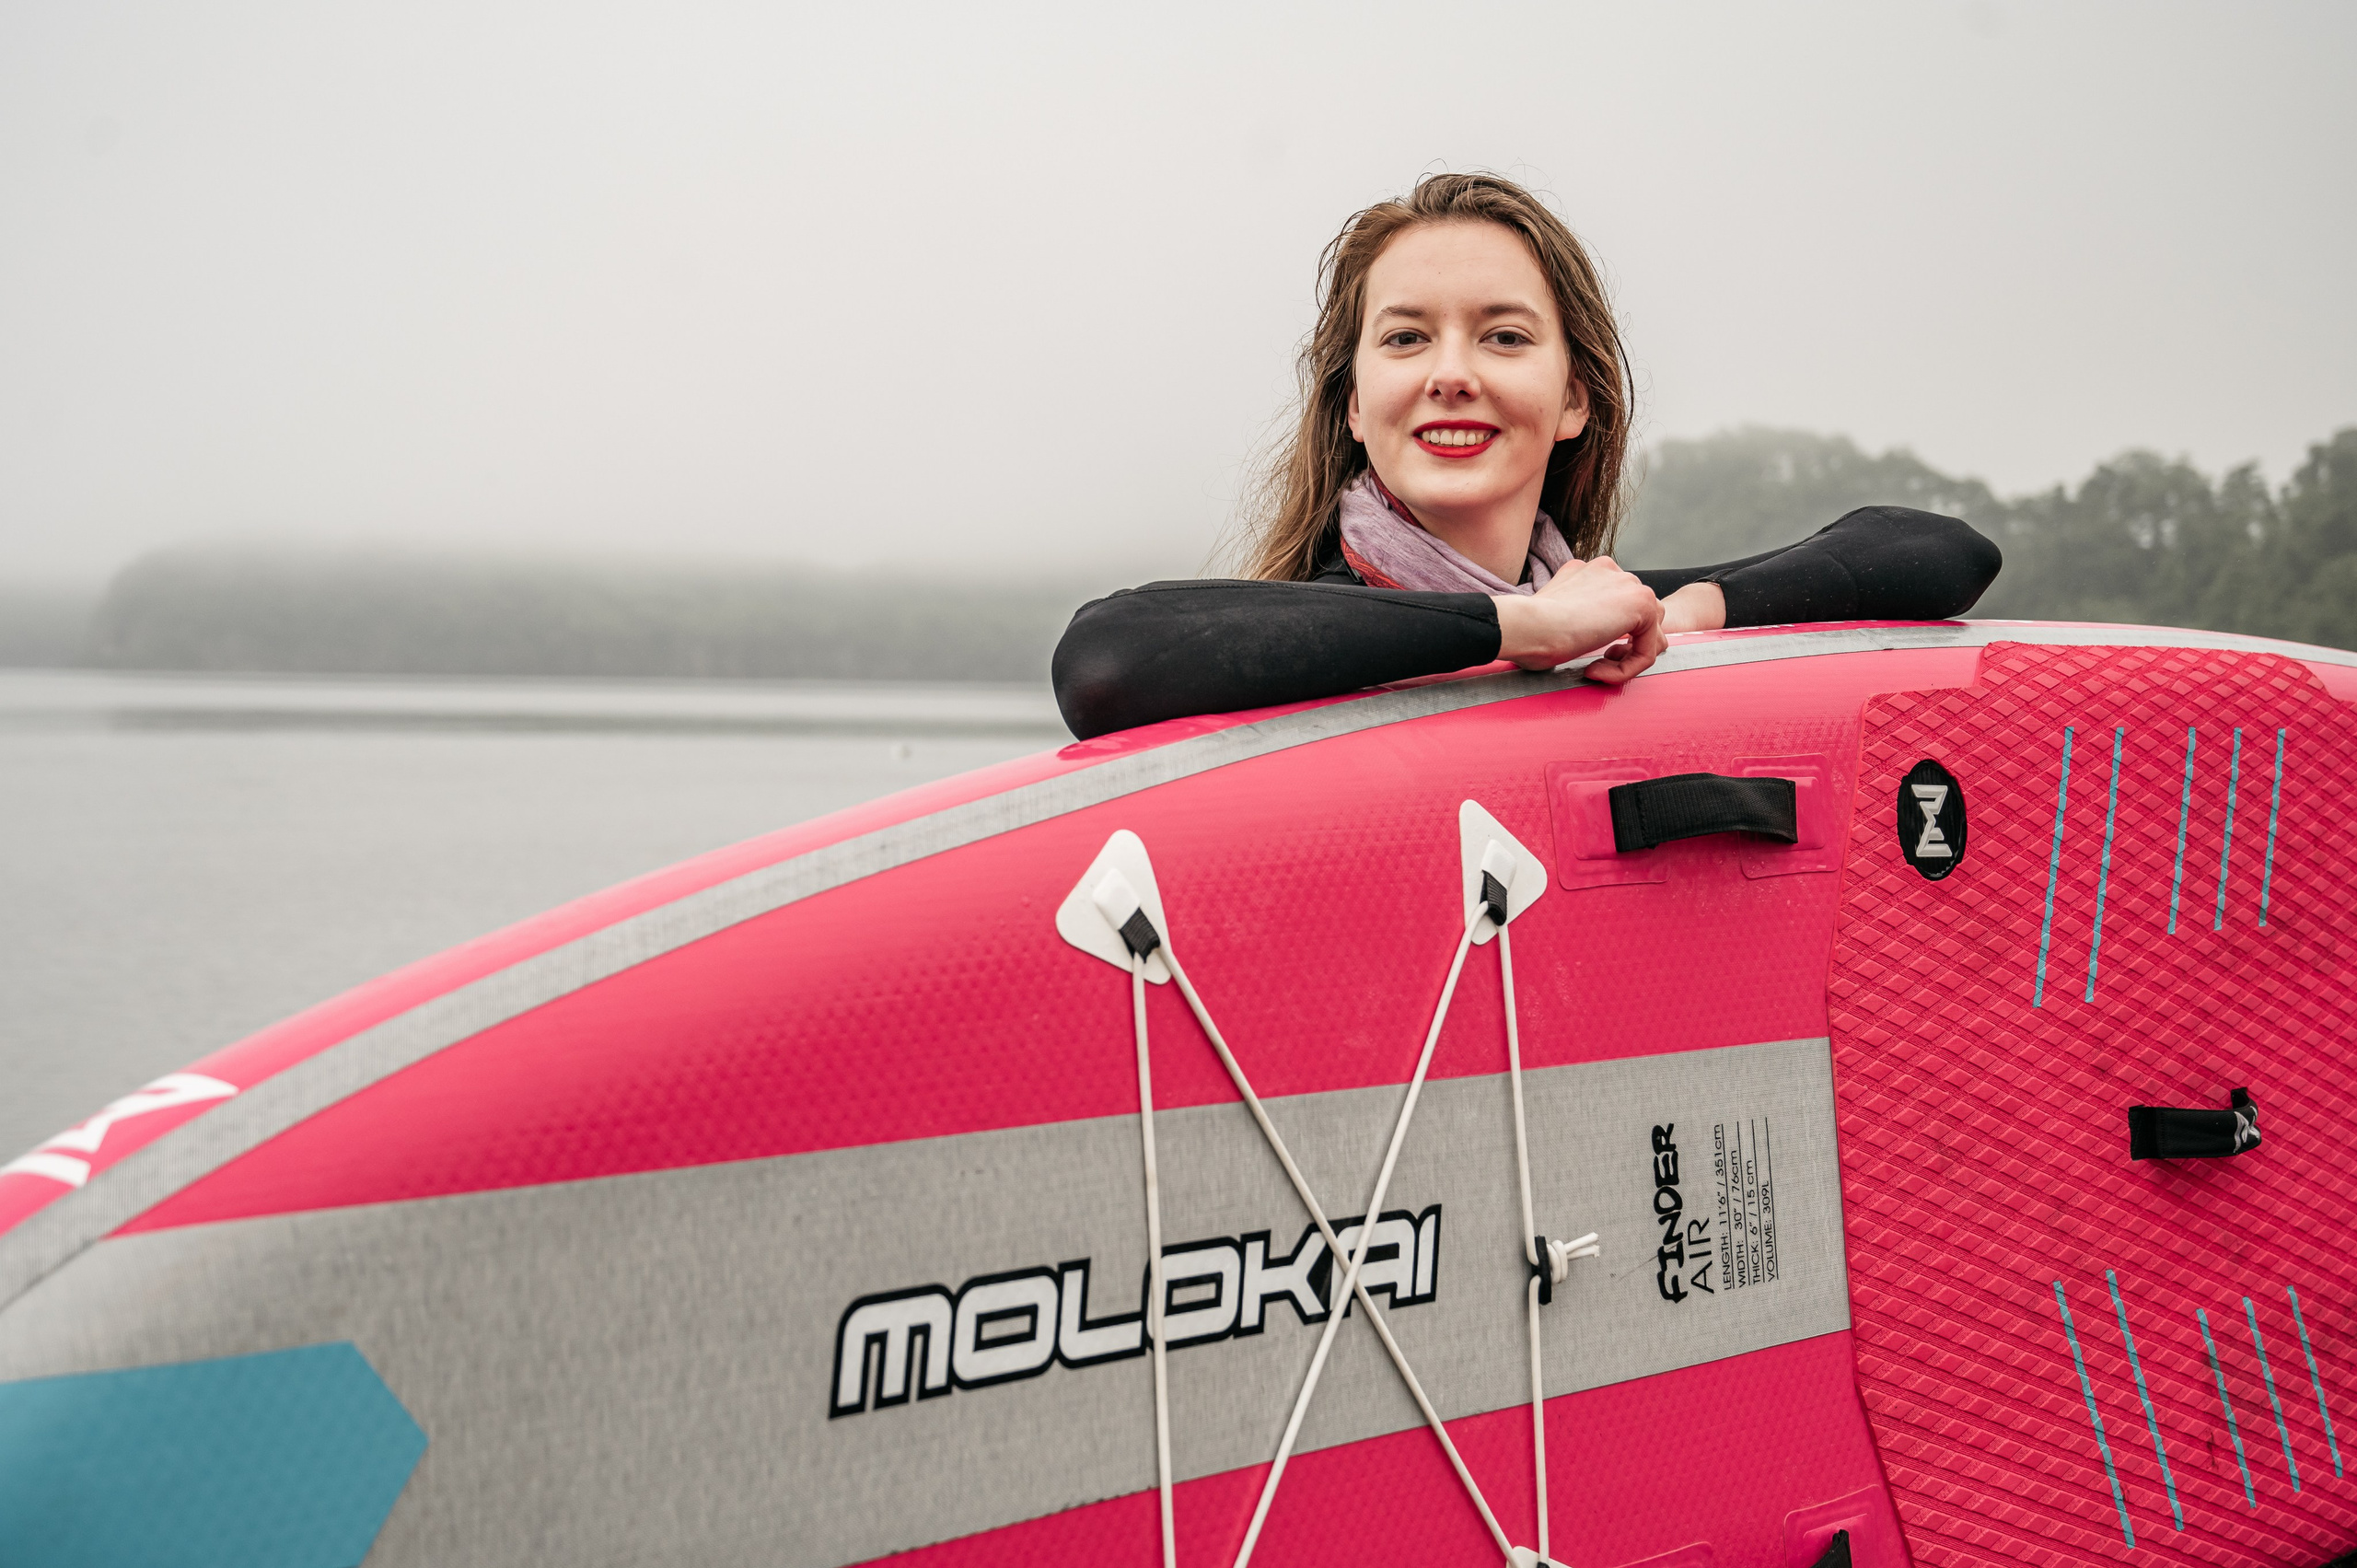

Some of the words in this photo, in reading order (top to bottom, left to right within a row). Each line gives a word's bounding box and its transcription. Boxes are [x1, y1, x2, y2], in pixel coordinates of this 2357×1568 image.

[1713, 1125, 1724, 1176] 351cm
[1731, 1151, 1740, 1191] 76cm
[1746, 1160, 1754, 1184] cm
[1651, 1123, 1688, 1304] FINDER
[1747, 1190, 1755, 1205] 15
[1762, 1181, 1771, 1214] 309L
[1688, 1218, 1714, 1294] AIR
[1721, 1233, 1732, 1290] LENGTH:
[1736, 1240, 1746, 1287] WIDTH:
[1750, 1241, 1761, 1283] THICK:
[1764, 1220, 1775, 1282] VOLUME:
[829, 1203, 1442, 1419] MOLOKAI
